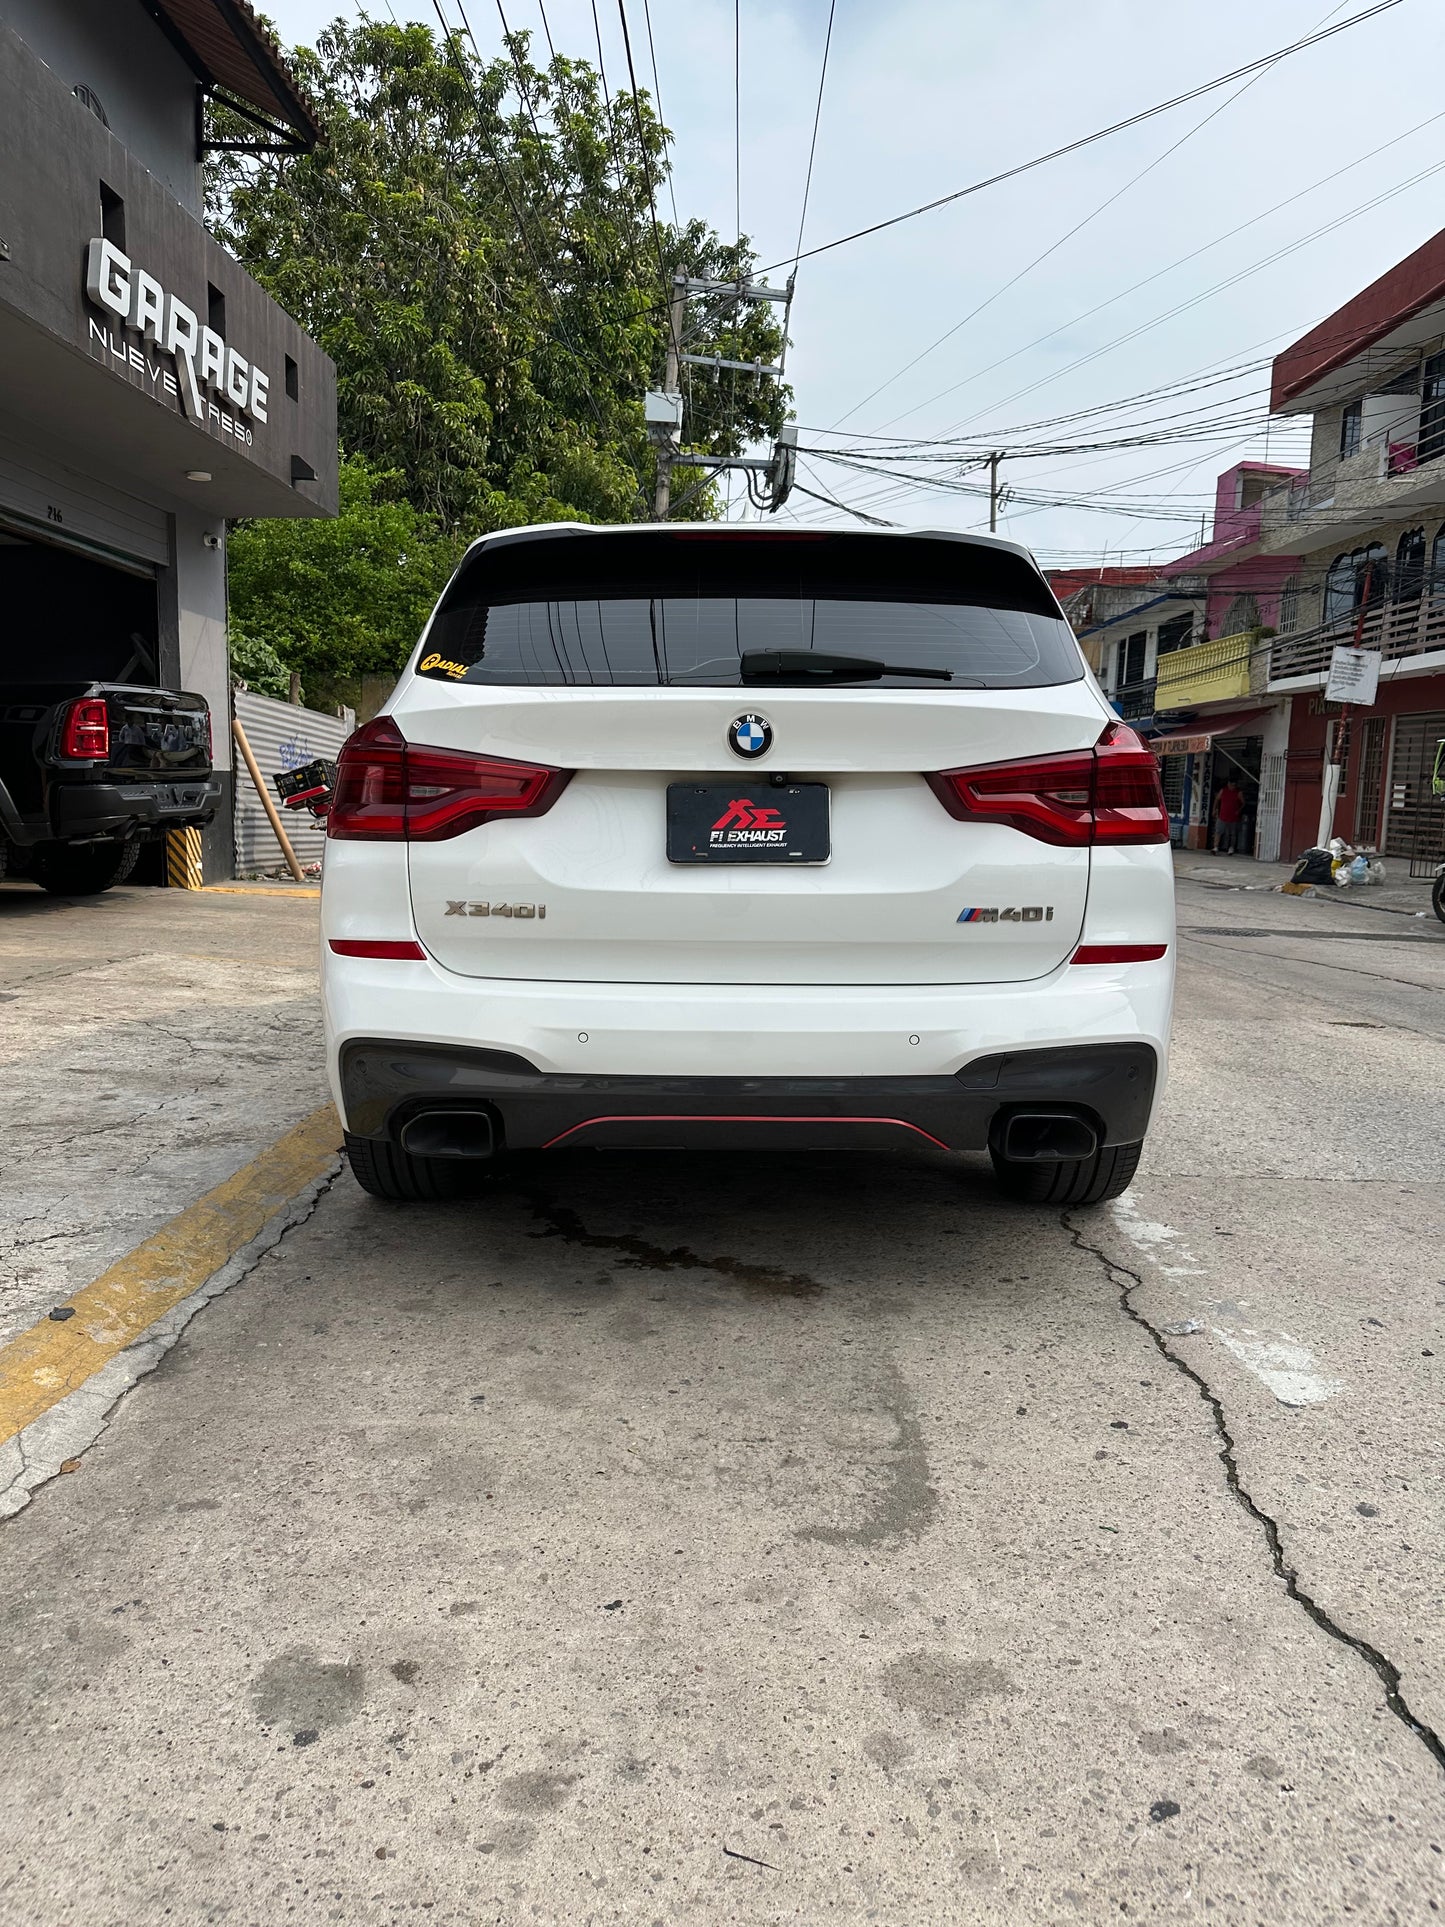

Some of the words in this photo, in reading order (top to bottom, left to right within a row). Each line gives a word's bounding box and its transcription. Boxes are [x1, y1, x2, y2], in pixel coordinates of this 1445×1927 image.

[88, 237, 270, 424] GARAGE
[89, 316, 178, 396] NUEVE
[48, 505, 62, 523] 216
[420, 652, 470, 676] RADIAL
[732, 714, 769, 730] BMW
[727, 829, 787, 842] EXHAUST
[444, 901, 546, 919] X340i
